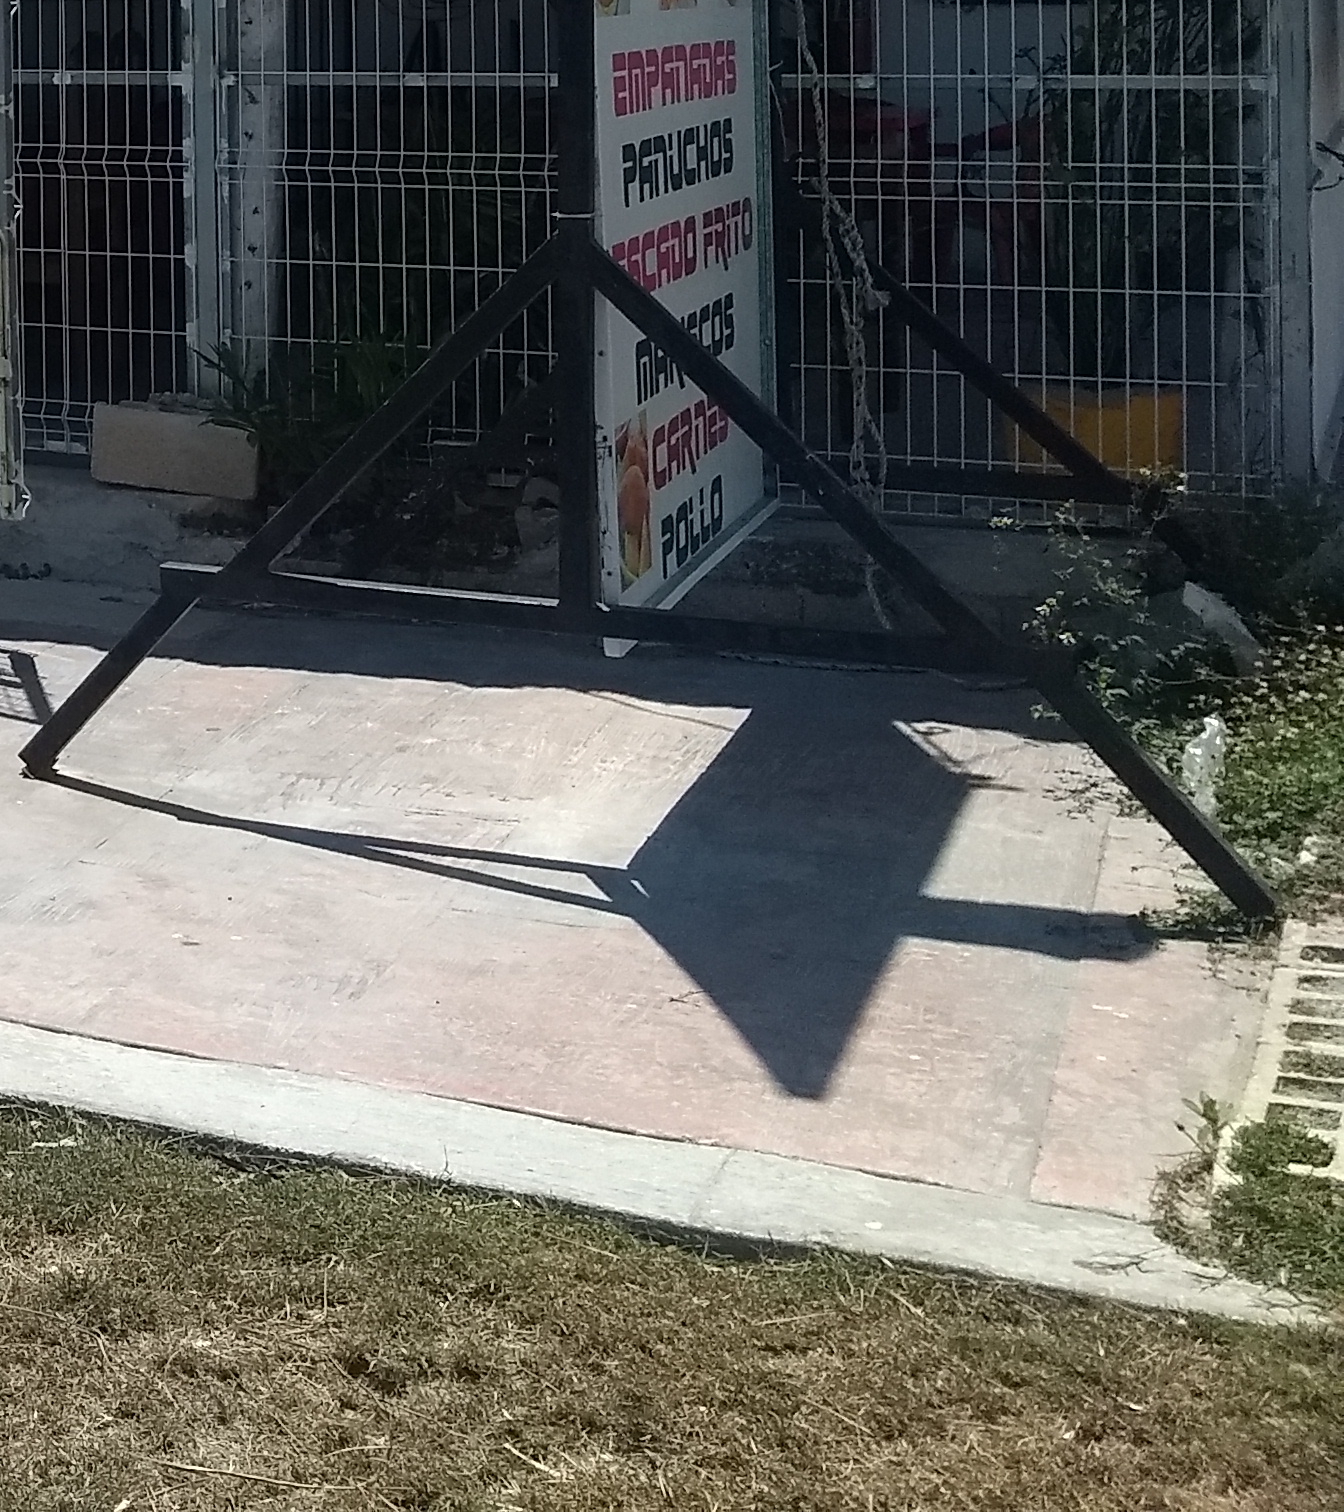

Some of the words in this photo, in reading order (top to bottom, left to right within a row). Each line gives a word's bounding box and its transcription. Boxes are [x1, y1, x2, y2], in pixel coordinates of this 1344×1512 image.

[612, 39, 737, 117] EMPANADAS
[621, 118, 733, 208] PANUCHOS
[702, 197, 753, 271] FRITO
[636, 292, 736, 405] MASCOS
[652, 399, 729, 490] CARNES
[661, 475, 723, 579] POLLO
